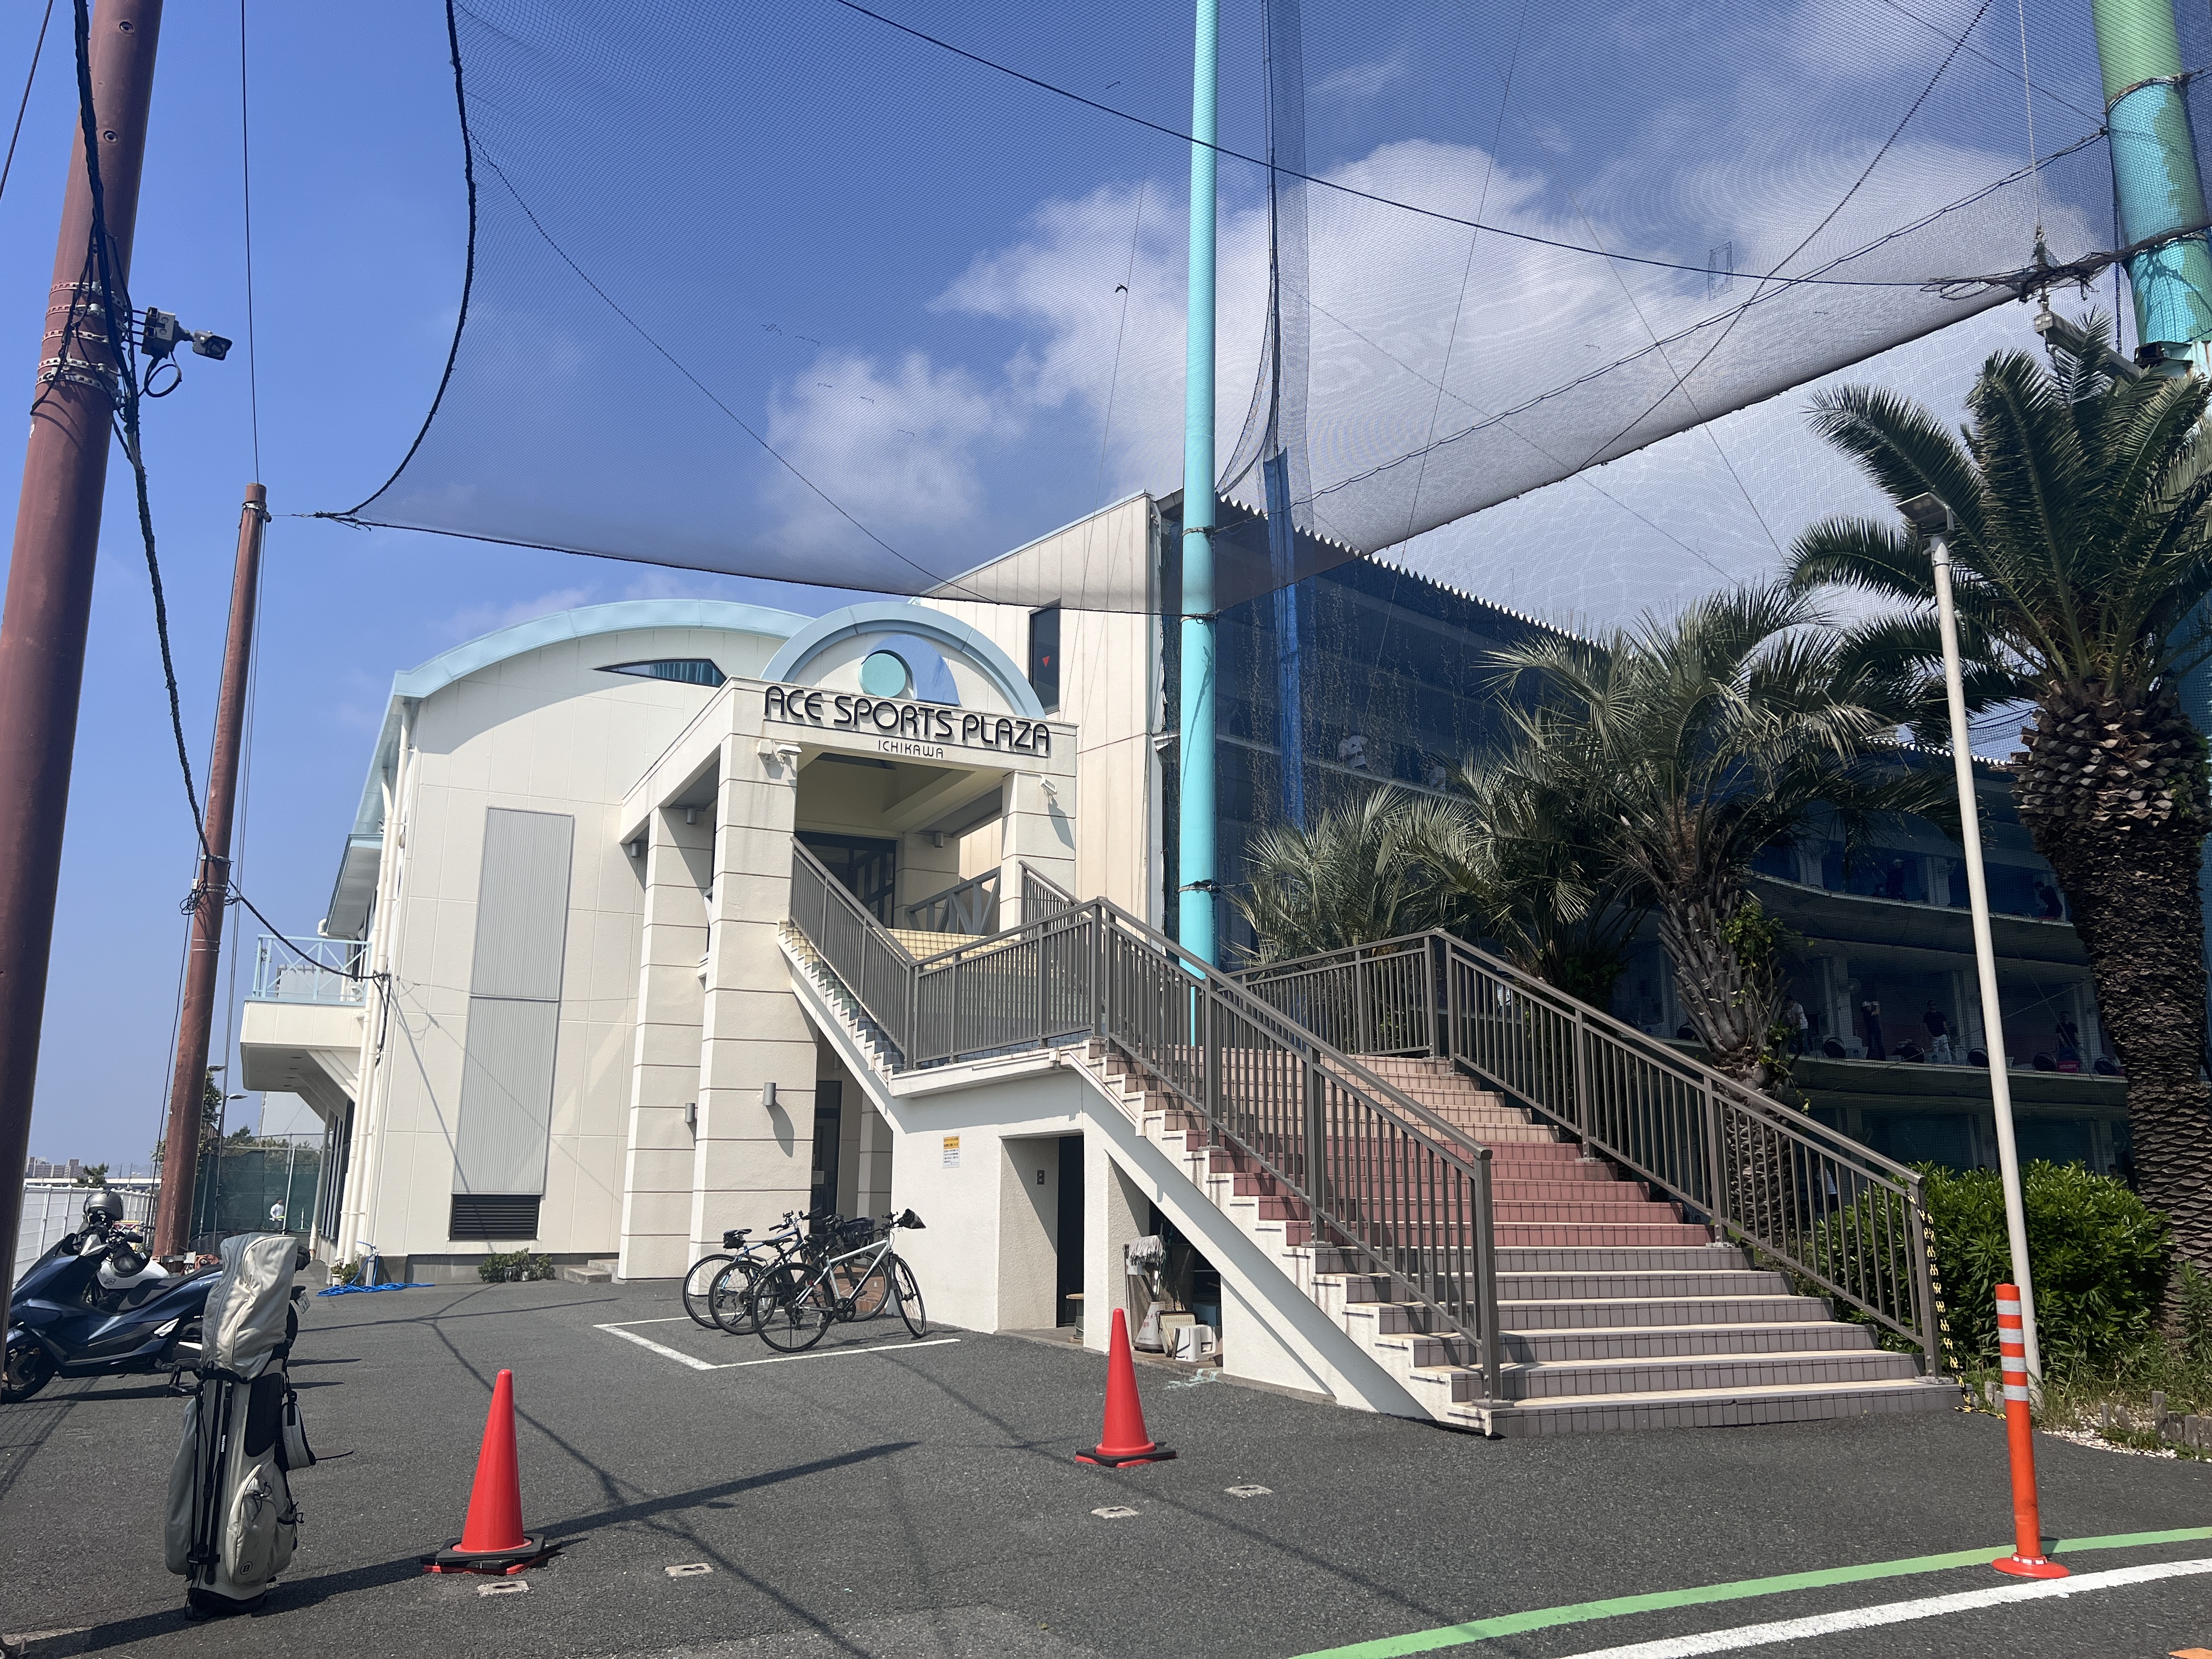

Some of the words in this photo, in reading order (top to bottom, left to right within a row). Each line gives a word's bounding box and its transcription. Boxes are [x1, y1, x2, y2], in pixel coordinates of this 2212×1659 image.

[765, 686, 822, 720] ACE
[834, 696, 952, 737] SPORTS
[962, 714, 1049, 751] PLAZA
[878, 740, 943, 759] ICHIKAWA
